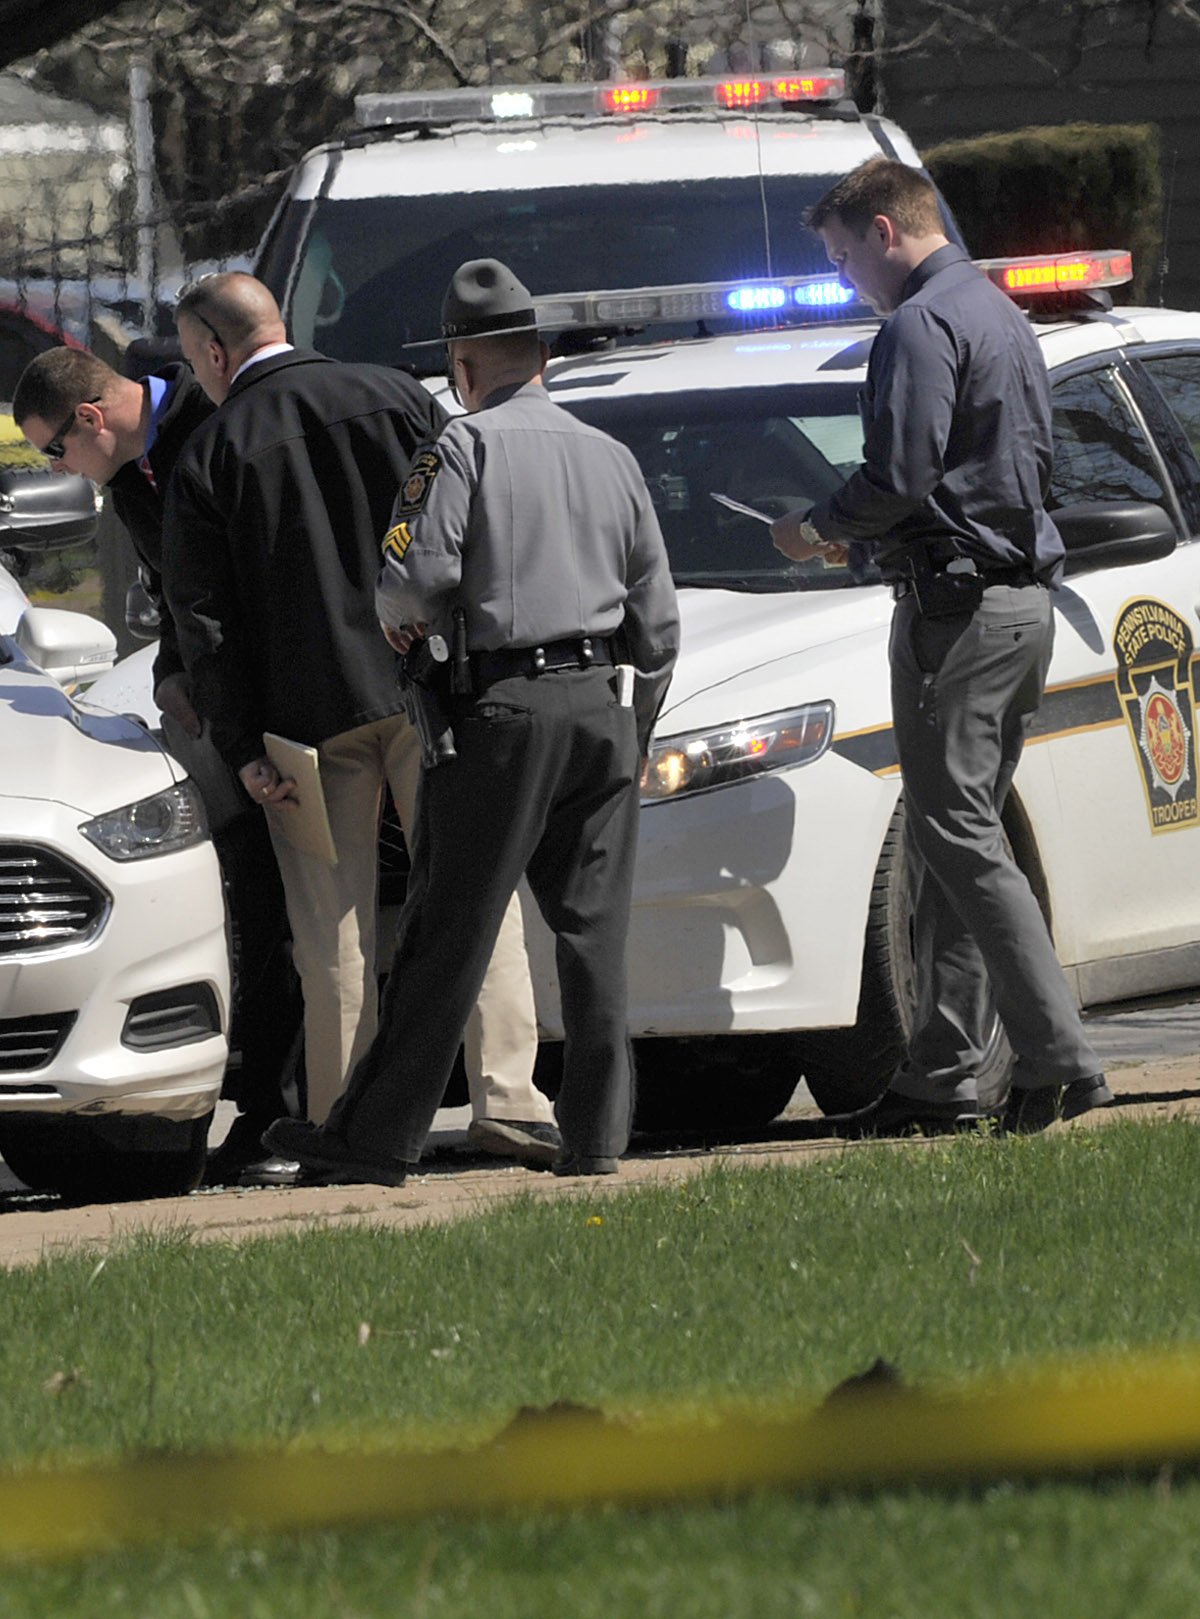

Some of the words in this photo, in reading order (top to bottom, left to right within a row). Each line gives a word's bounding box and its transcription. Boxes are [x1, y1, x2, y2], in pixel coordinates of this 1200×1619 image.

[1117, 605, 1184, 651] PENNSYLVANIA
[1124, 627, 1148, 667] STATE
[1148, 626, 1186, 658] POLICE
[1153, 799, 1197, 824] TROOPER
